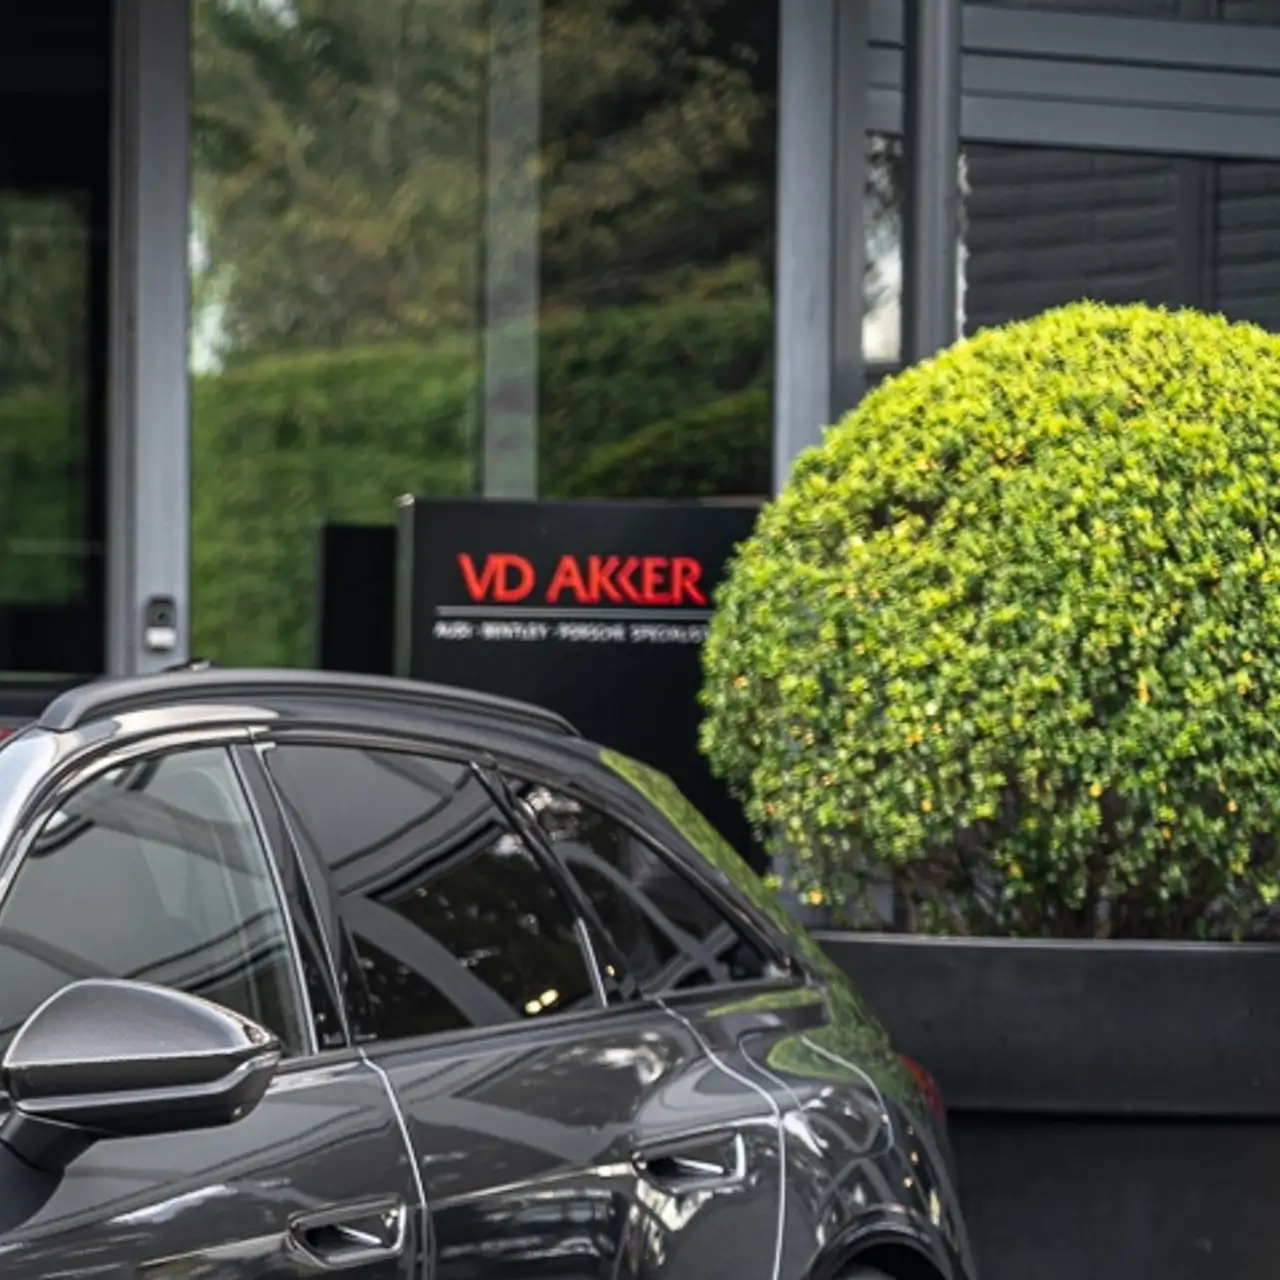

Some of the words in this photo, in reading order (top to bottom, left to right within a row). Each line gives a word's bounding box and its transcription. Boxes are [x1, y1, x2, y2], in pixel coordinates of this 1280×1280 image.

[457, 552, 536, 602] VD
[545, 554, 707, 606] AKKER
[479, 621, 548, 642] BENTLEY
[558, 622, 627, 643] PORSCHE
